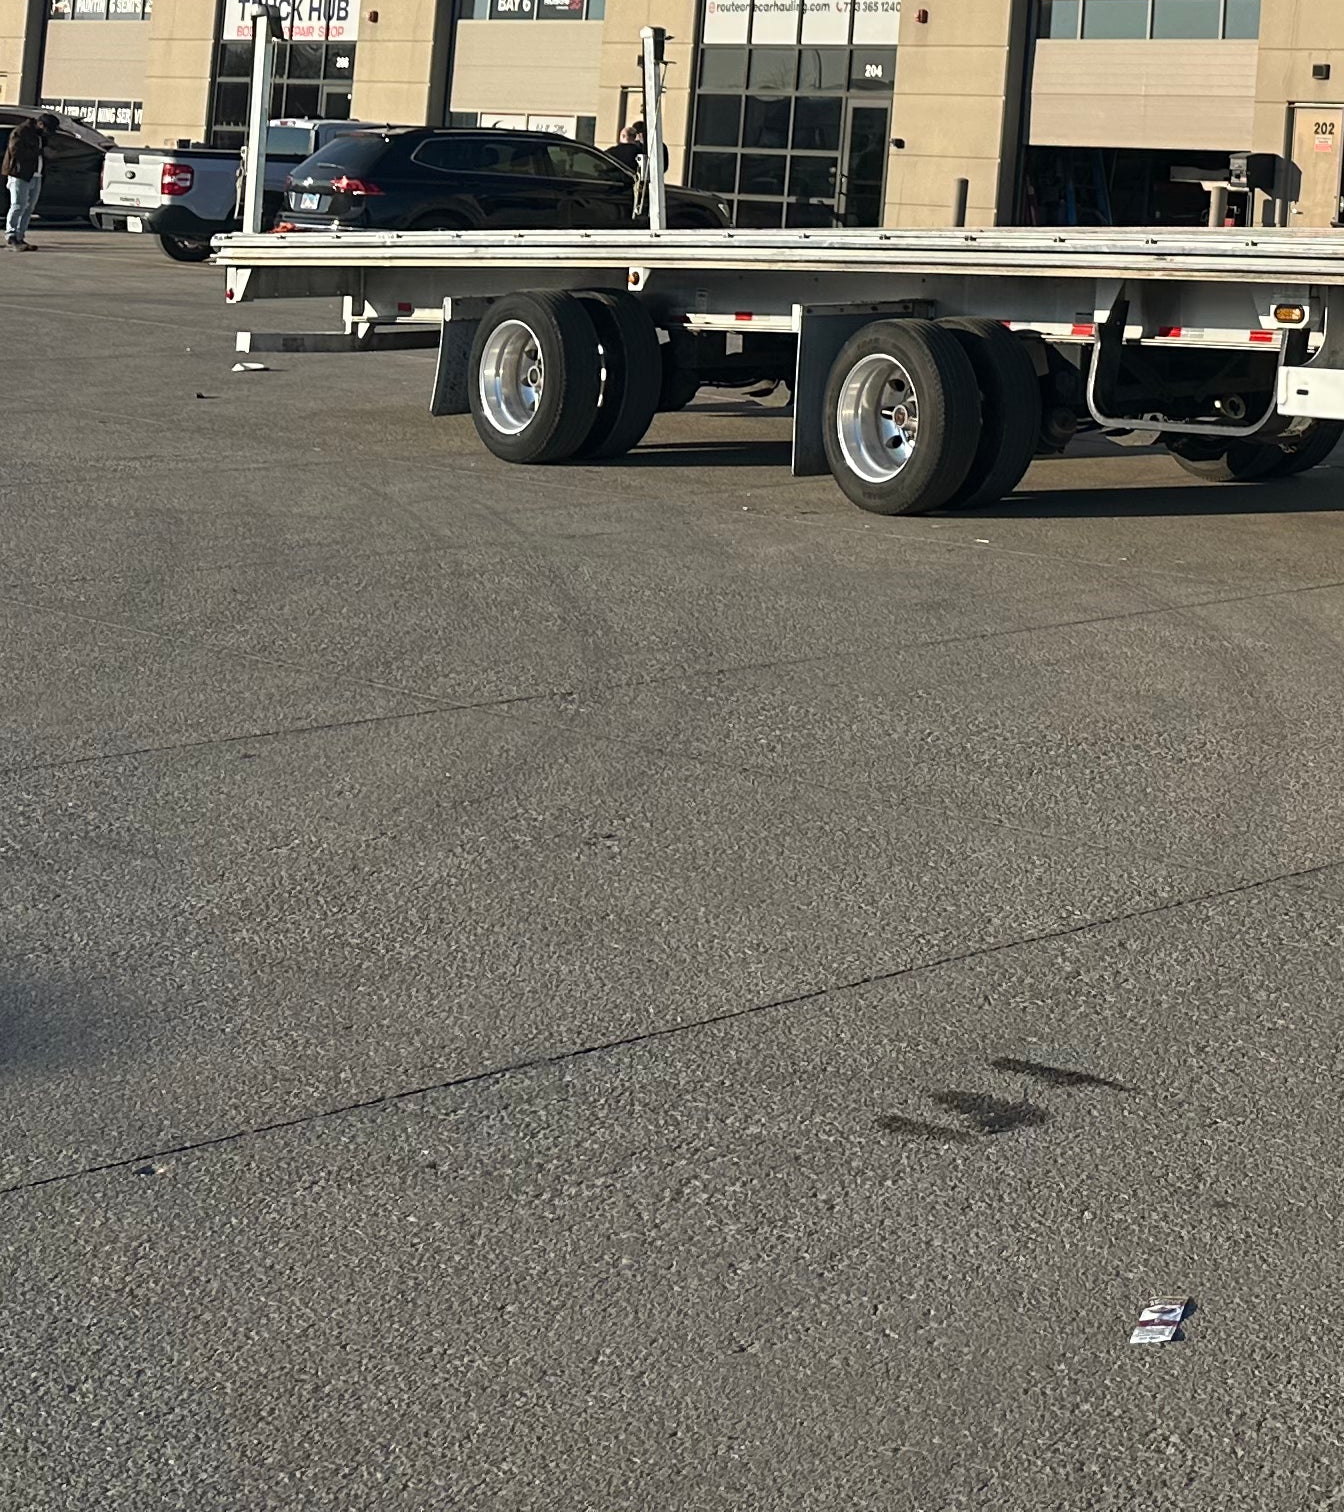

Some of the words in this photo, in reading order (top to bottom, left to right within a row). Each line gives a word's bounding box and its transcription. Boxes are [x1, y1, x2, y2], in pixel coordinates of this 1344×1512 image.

[318, 26, 344, 38] SOP
[864, 64, 883, 78] 204
[1314, 122, 1335, 135] 202
